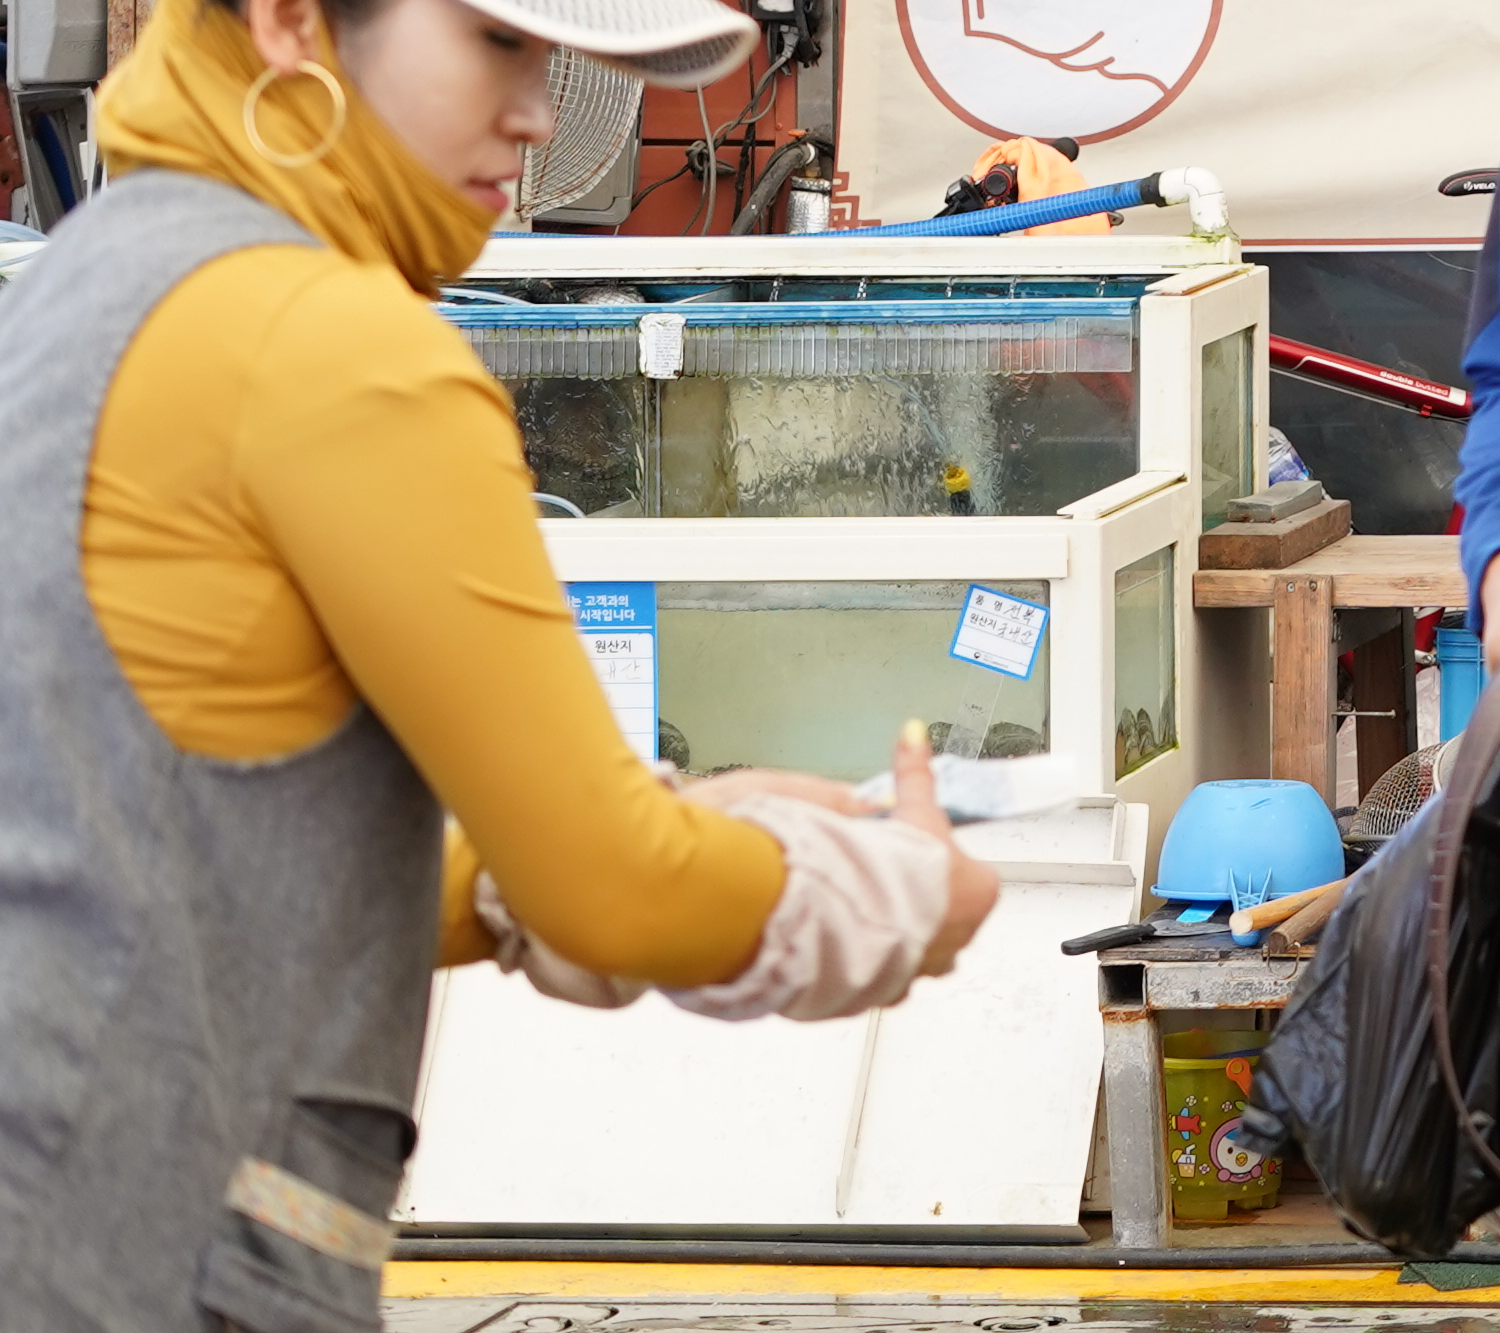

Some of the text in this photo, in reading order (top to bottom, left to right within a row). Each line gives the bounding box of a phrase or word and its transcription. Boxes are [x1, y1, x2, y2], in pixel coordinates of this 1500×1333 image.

[585, 595, 629, 608] 고객과의
[580, 608, 636, 622] 시작입니다
[595, 640, 632, 653] 원산지
